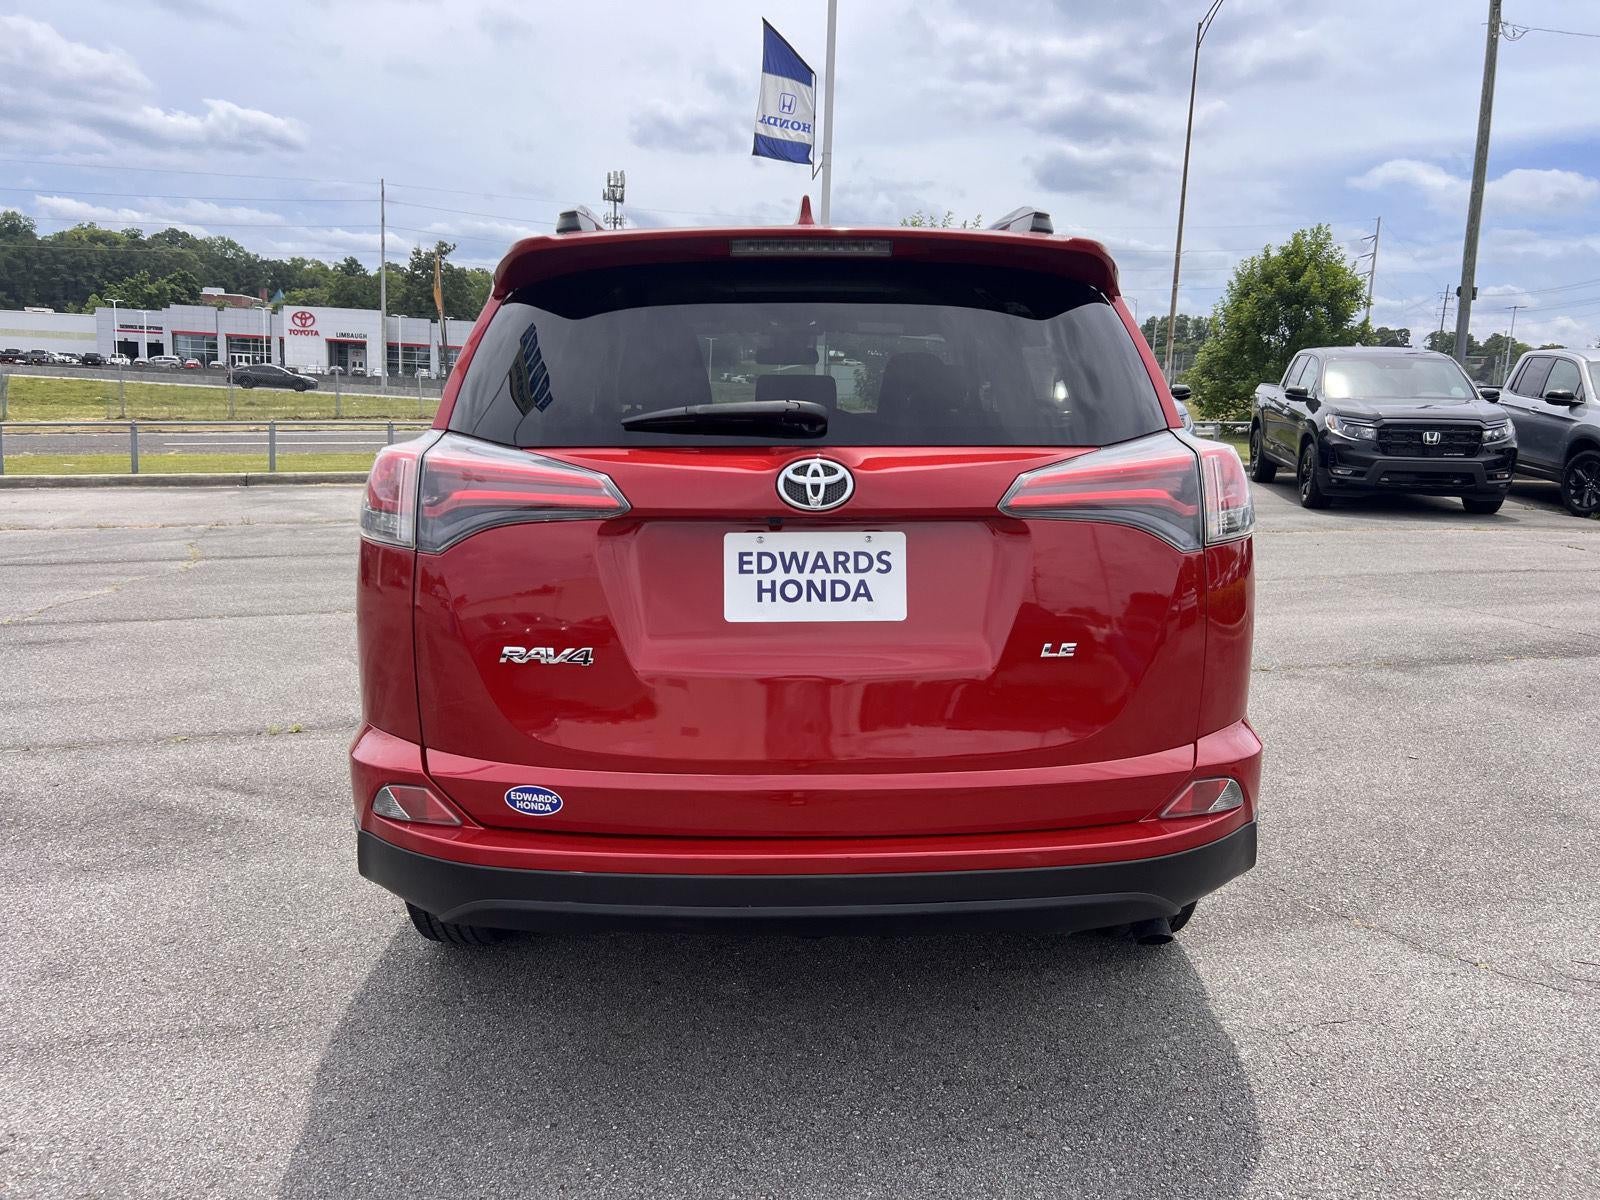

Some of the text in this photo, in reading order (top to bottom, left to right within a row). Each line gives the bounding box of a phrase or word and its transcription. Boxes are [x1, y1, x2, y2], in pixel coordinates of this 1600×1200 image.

[288, 328, 319, 337] TOYOTA
[738, 550, 892, 575] EDWARDS
[757, 579, 874, 603] HONDA
[499, 646, 594, 666] RAV4
[1040, 642, 1077, 657] LE
[510, 791, 557, 804] EDWARDS
[516, 801, 552, 811] HONDA
